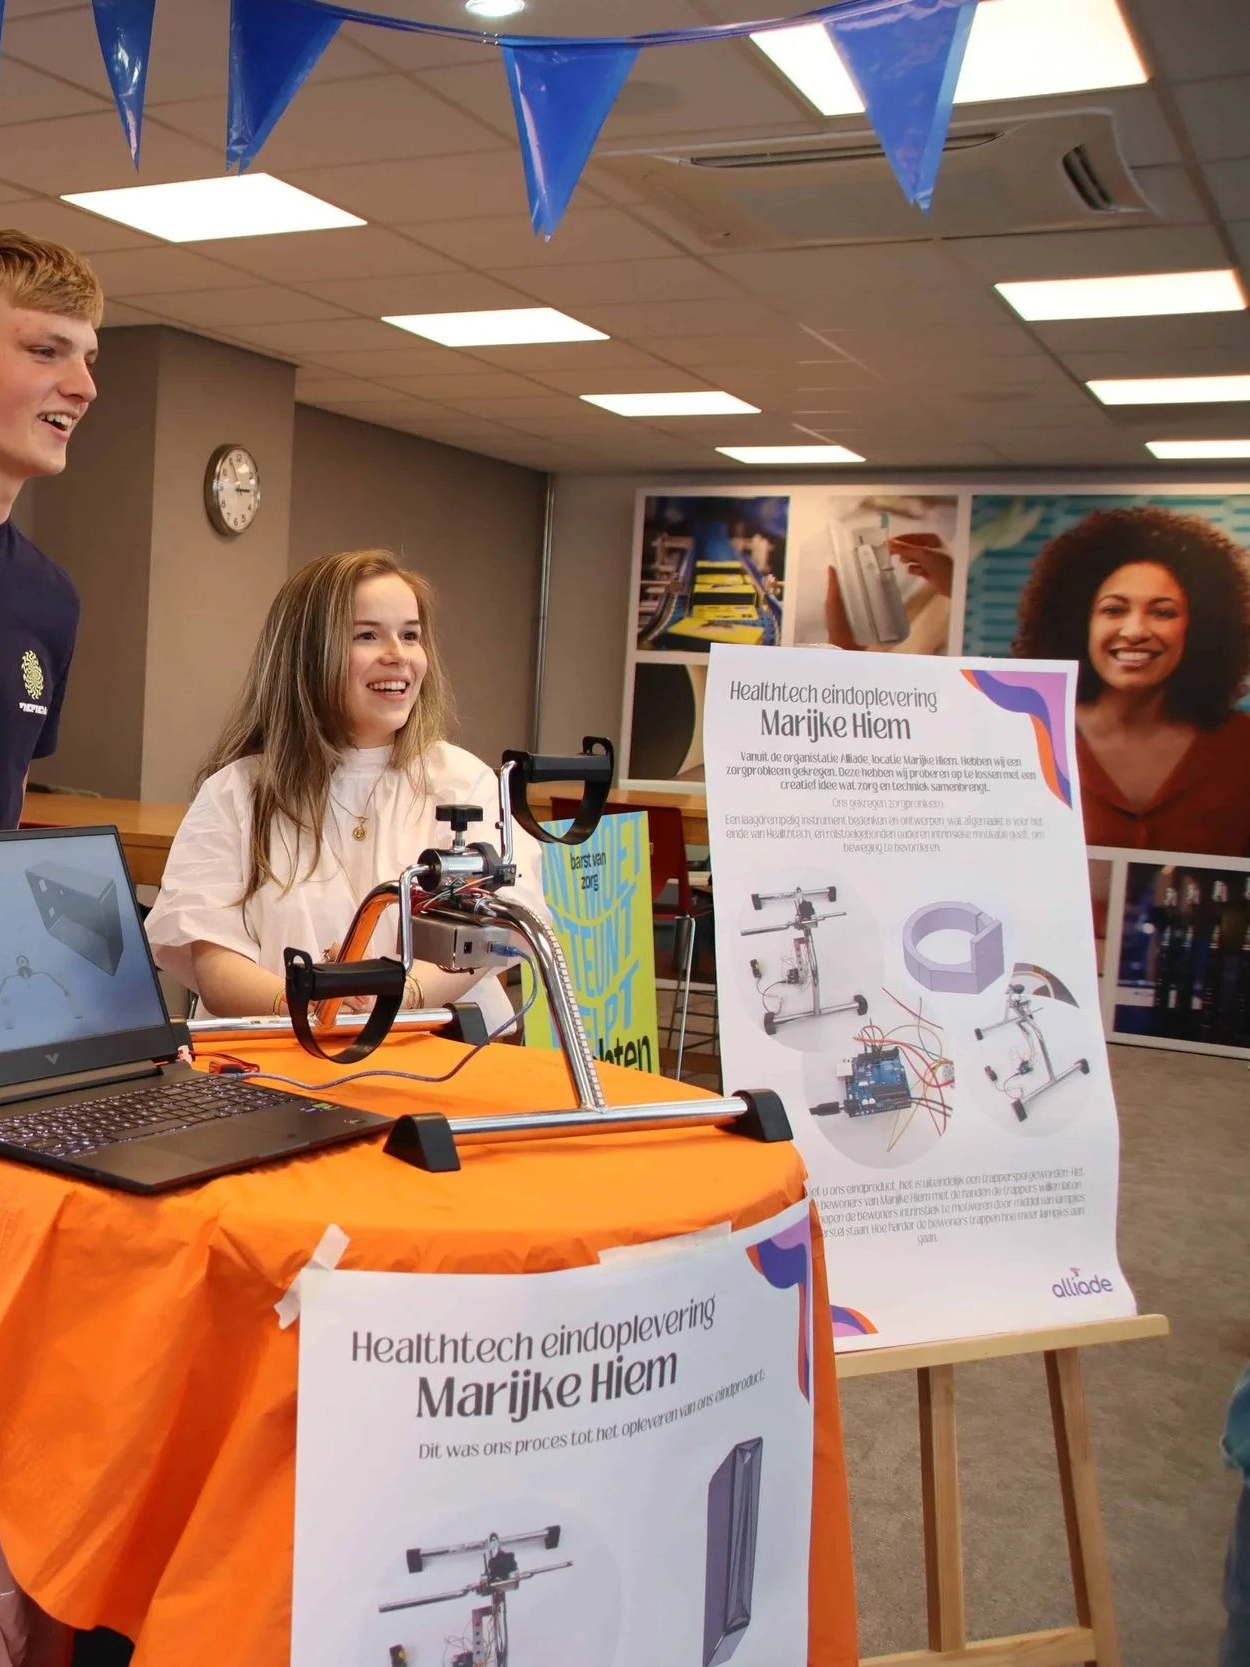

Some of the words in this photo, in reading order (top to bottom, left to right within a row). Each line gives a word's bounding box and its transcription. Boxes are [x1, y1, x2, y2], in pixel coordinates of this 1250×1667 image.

[730, 680, 818, 704] Healthtech
[821, 684, 938, 713] eindoplevering
[760, 708, 848, 743] Marijke
[852, 711, 911, 739] Hiem
[740, 751, 768, 762] Vanuit
[770, 752, 782, 762] de
[903, 754, 935, 767] Marijke
[1006, 757, 1022, 767] een
[726, 766, 791, 778] zorgprobleem
[838, 767, 860, 777] Deze
[861, 767, 894, 778] hebben
[910, 768, 950, 781] proberen
[780, 779, 817, 790] creatief
[818, 779, 838, 791] idee
[838, 780, 857, 791] wat
[858, 781, 879, 793] zorg
[892, 781, 930, 793] techniek
[570, 852, 591, 870] barst
[592, 852, 607, 867] van
[581, 874, 599, 891] zorg
[1052, 1274, 1114, 1298] alliade
[351, 1330, 533, 1364] Healthtech
[540, 1293, 715, 1358] eindoplevering
[416, 1368, 582, 1423] Marijke
[590, 1352, 677, 1403] Hiem
[418, 1442, 442, 1460] Dit
[444, 1441, 479, 1458] was
[482, 1440, 512, 1456] ons
[514, 1435, 568, 1457] proces
[570, 1427, 594, 1444] tot
[596, 1423, 619, 1441] het
[621, 1407, 679, 1437] opleveren
[679, 1402, 697, 1420] van
[697, 1394, 714, 1411] ons
[714, 1368, 766, 1404] eindproduct:
